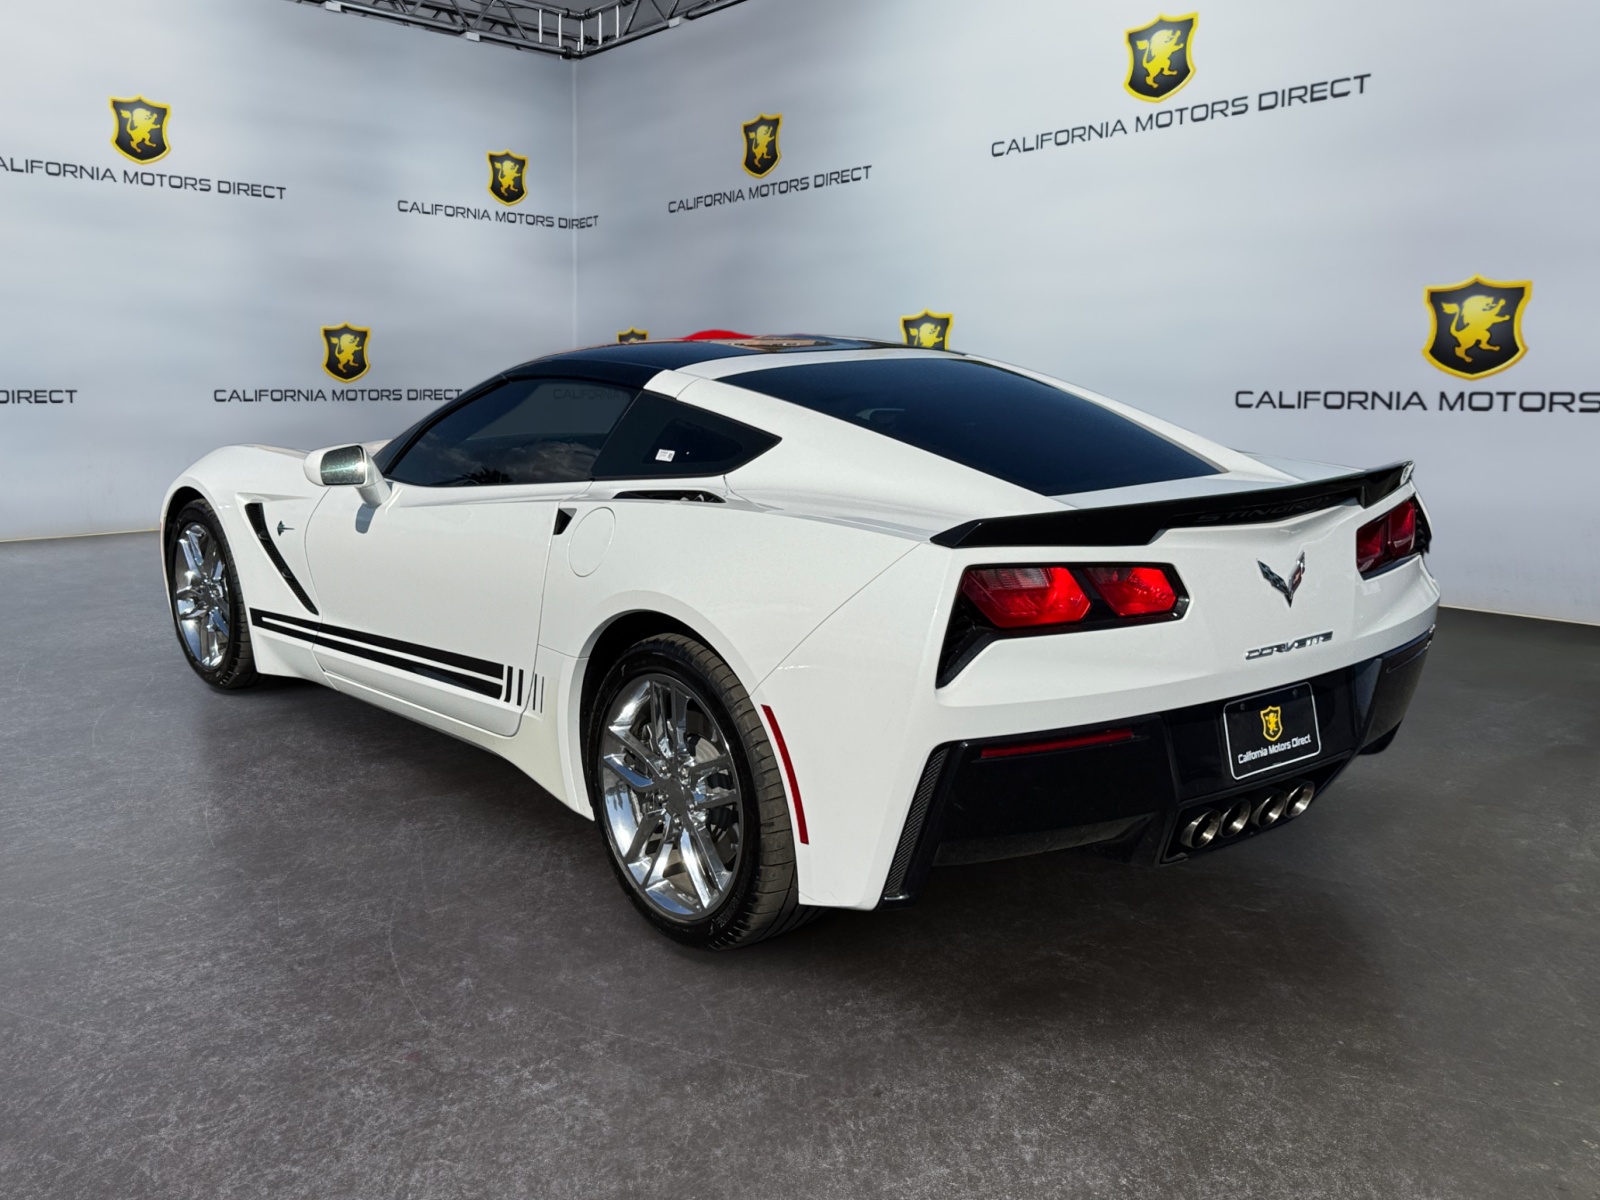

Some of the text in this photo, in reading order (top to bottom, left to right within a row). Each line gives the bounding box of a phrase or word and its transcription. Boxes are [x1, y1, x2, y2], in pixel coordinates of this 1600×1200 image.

[991, 73, 1372, 158] CALIFORNIA MOTORS DIRECT
[0, 156, 287, 200] ALIFORNIA MOTORS DIRECT
[667, 165, 872, 214] CALIFORNIA MOTORS DIRECT
[397, 199, 599, 230] CALIFORNIA MOTORS DIRECT
[0, 389, 78, 404] DIRECT
[213, 388, 462, 402] CALIFORNIA MOTORS DIRECT
[1234, 390, 1600, 413] CALIFORNIA MOTORS
[1245, 630, 1333, 660] CORVETTE
[1238, 734, 1311, 764] California Motors Direct
